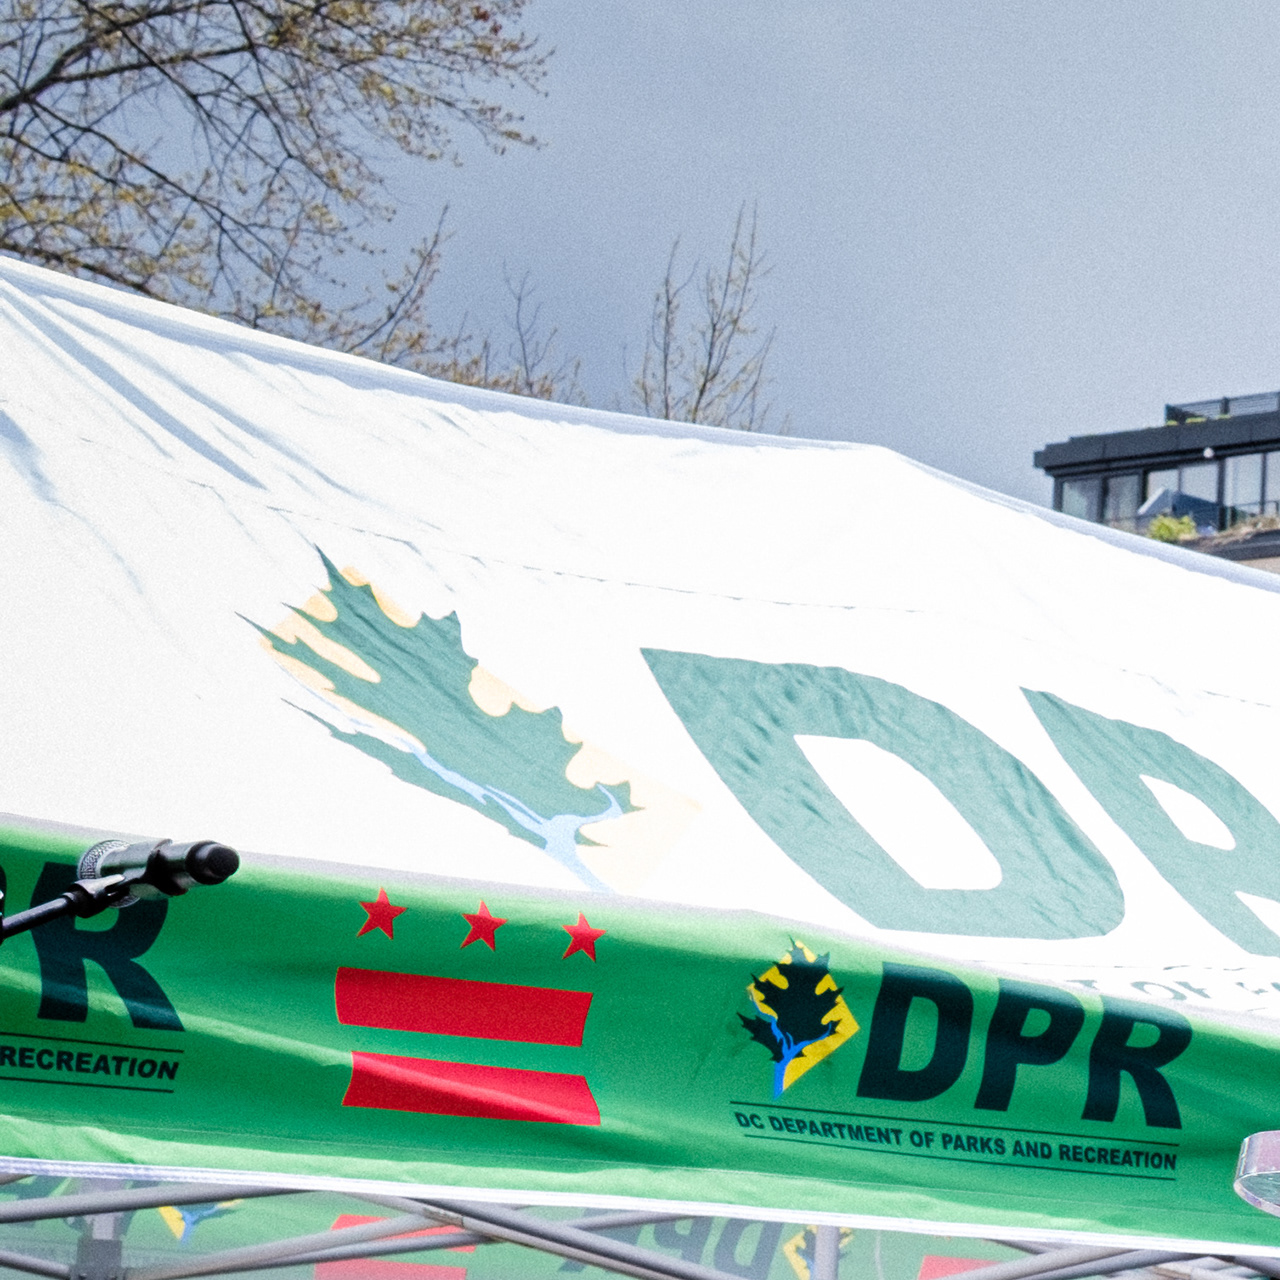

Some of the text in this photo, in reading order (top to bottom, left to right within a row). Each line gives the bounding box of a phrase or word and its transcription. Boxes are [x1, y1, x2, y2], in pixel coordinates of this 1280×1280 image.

[0, 1045, 179, 1080] RECREATION
[856, 961, 1194, 1130] DPR
[734, 1111, 1177, 1171] DC DEPARTMENT OF PARKS AND RECREATION
